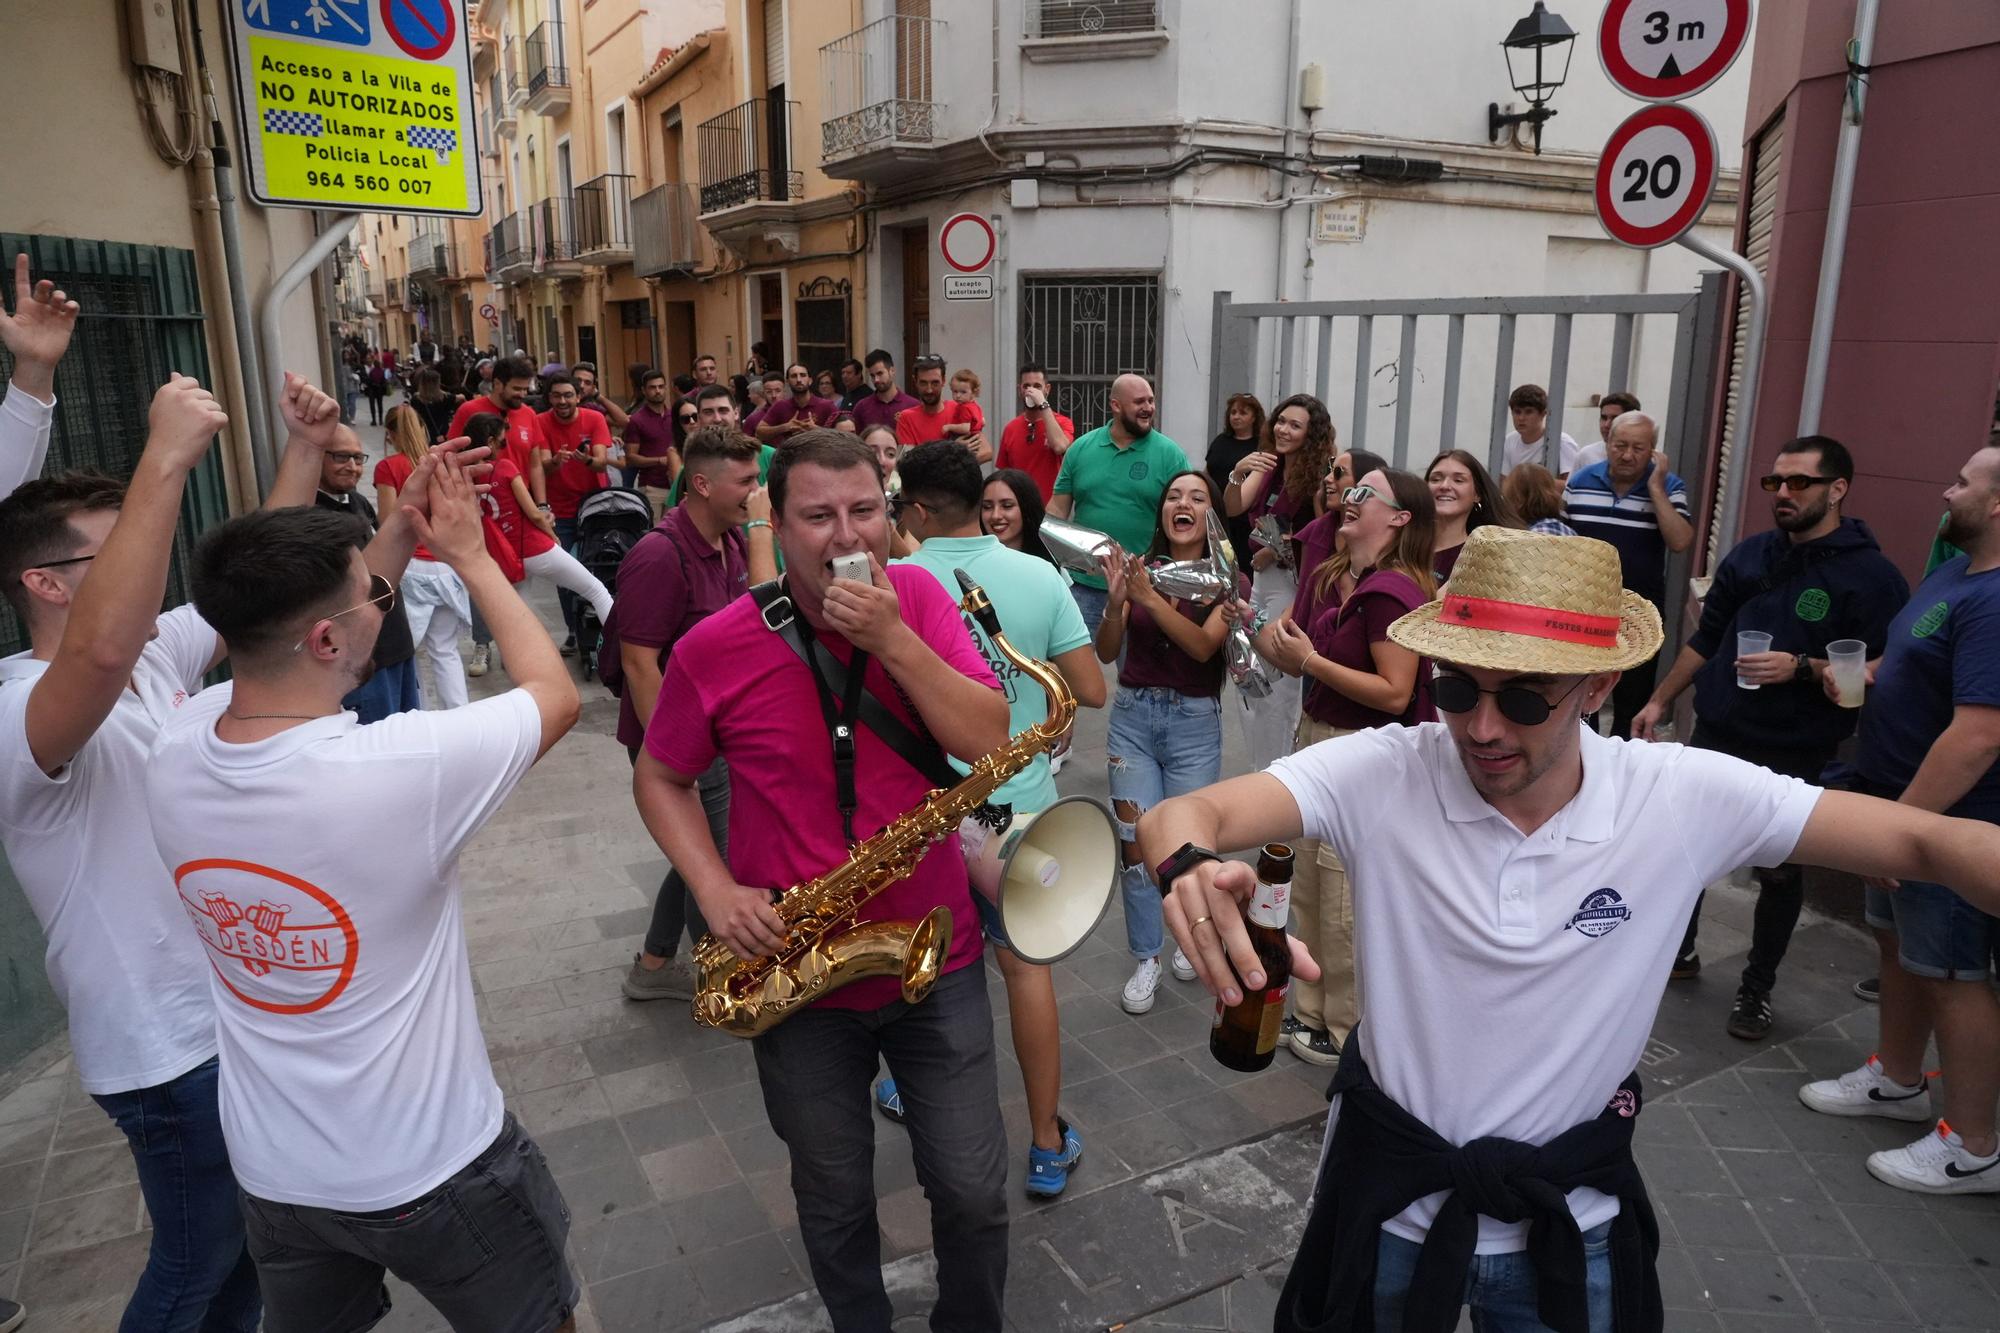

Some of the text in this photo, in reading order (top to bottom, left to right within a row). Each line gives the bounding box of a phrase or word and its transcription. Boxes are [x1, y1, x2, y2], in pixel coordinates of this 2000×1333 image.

[1643, 11, 1705, 45] 3 m
[261, 55, 451, 97] Acceso a la Vila de
[261, 81, 455, 122] NO AUTORIZADOS
[325, 118, 405, 142] llamar a
[379, 150, 428, 170] Local
[307, 171, 432, 195] 964 560 007
[1622, 154, 1681, 202] 20
[1544, 619, 1582, 633] FESTES
[217, 927, 330, 964] DESDÉN
